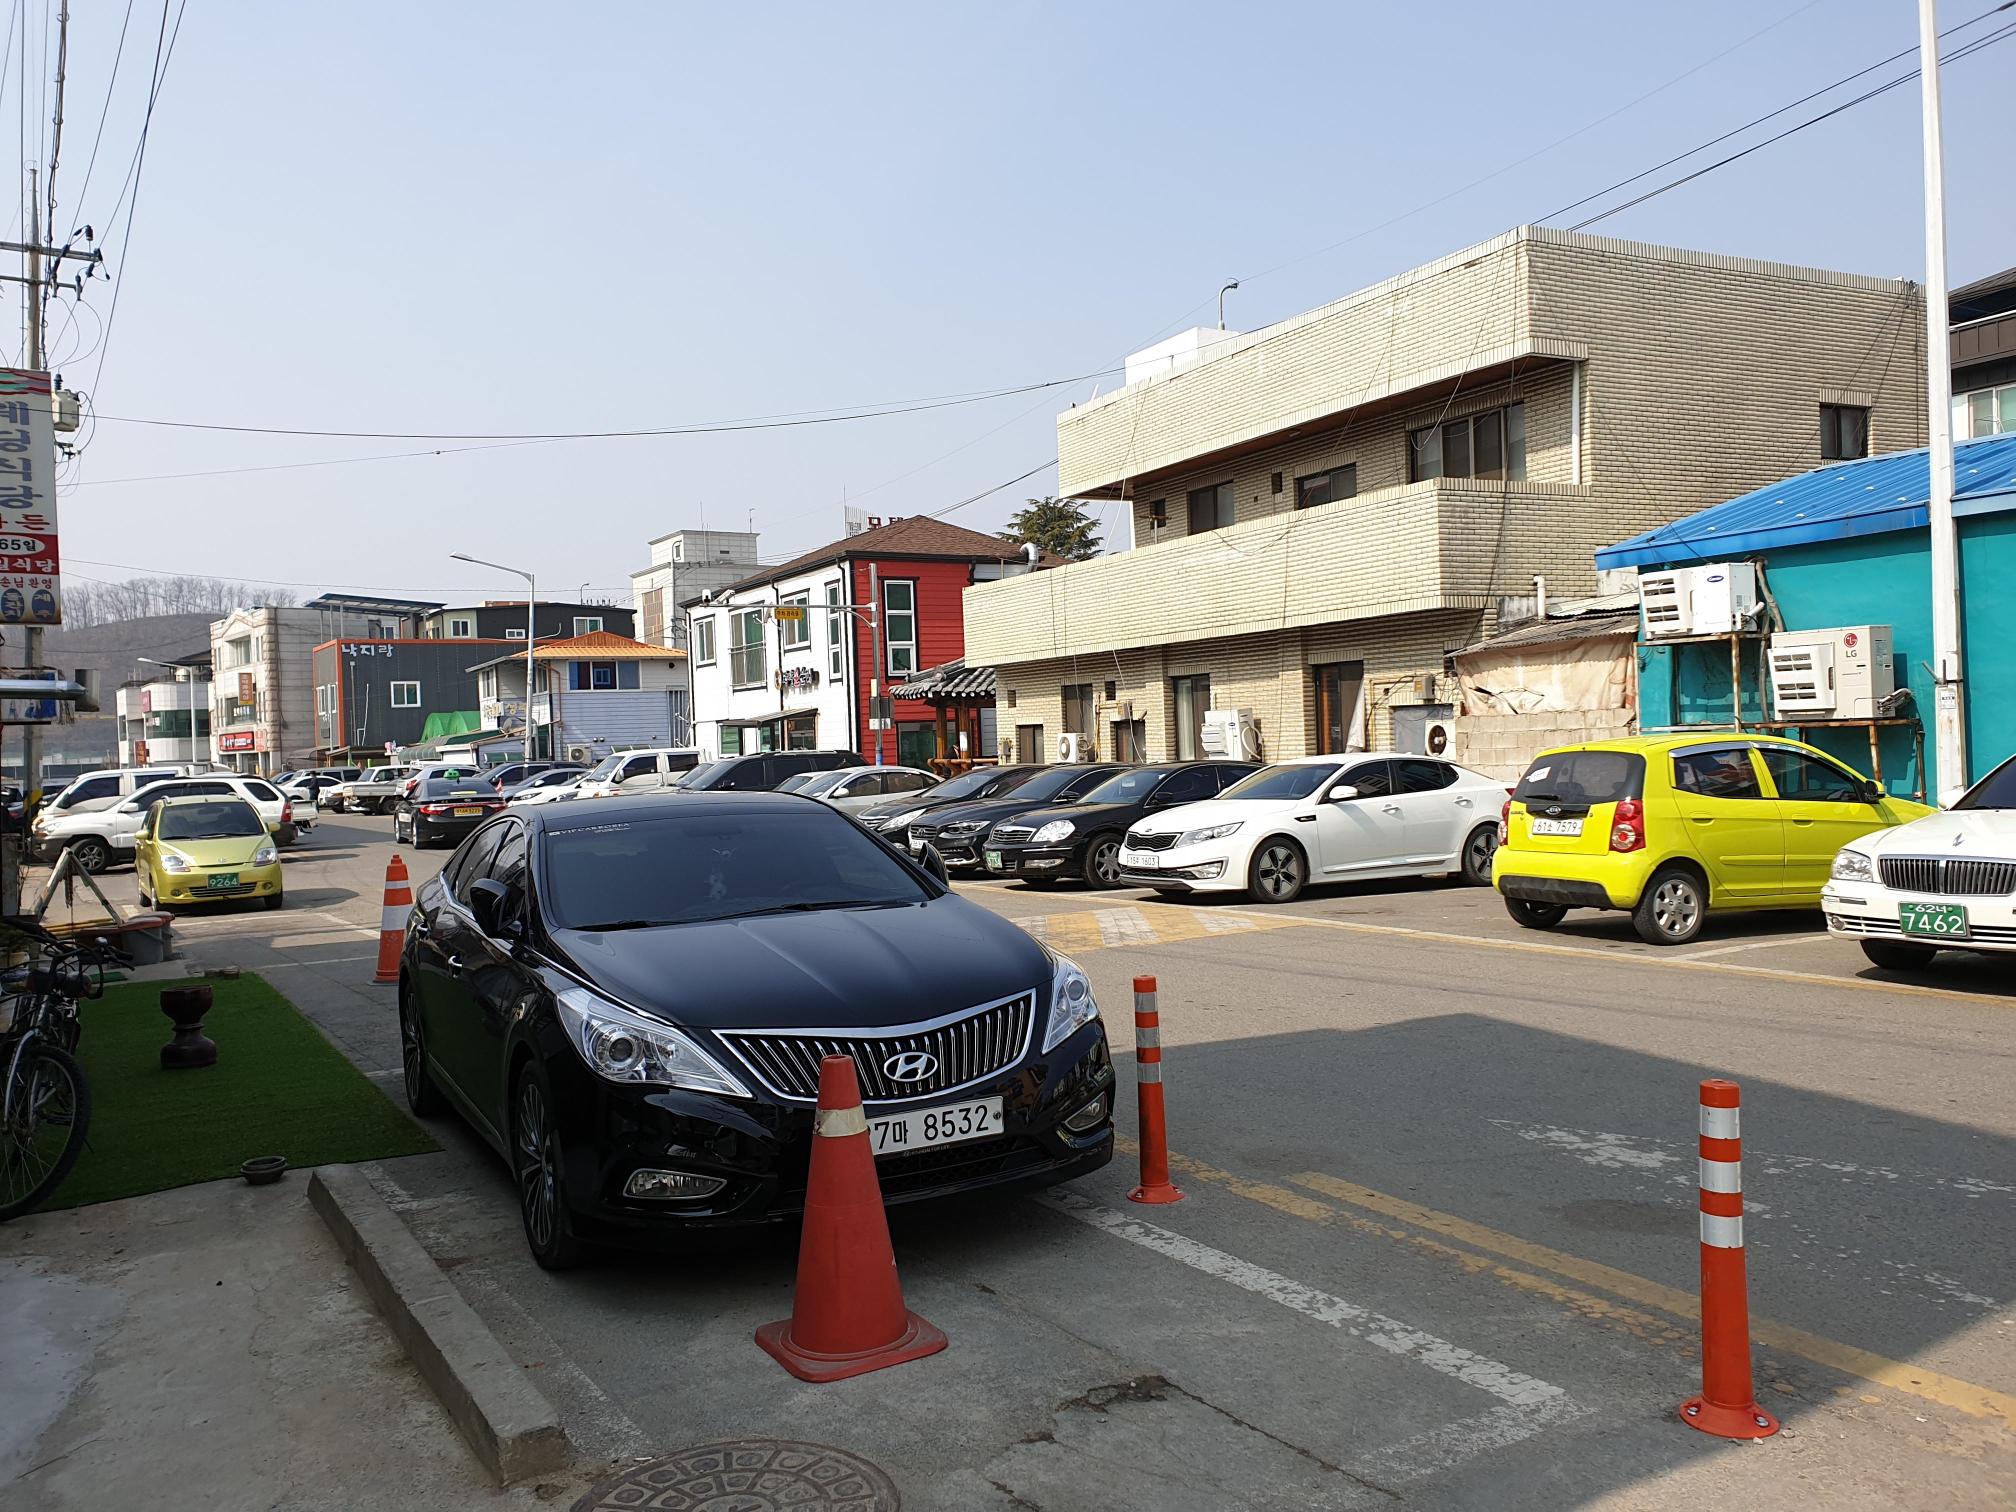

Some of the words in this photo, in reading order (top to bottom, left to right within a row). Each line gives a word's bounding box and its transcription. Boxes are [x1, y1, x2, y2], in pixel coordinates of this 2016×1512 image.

[341, 643, 394, 657] 낙지랑
[1845, 649, 1858, 658] LG
[1556, 821, 1578, 833] 7579
[1141, 857, 1156, 866] 1603
[209, 877, 238, 888] 9264
[1915, 904, 1947, 914] 62너
[1901, 912, 1964, 934] 7462
[867, 1120, 909, 1151] 7마
[923, 1104, 990, 1141] 8532
